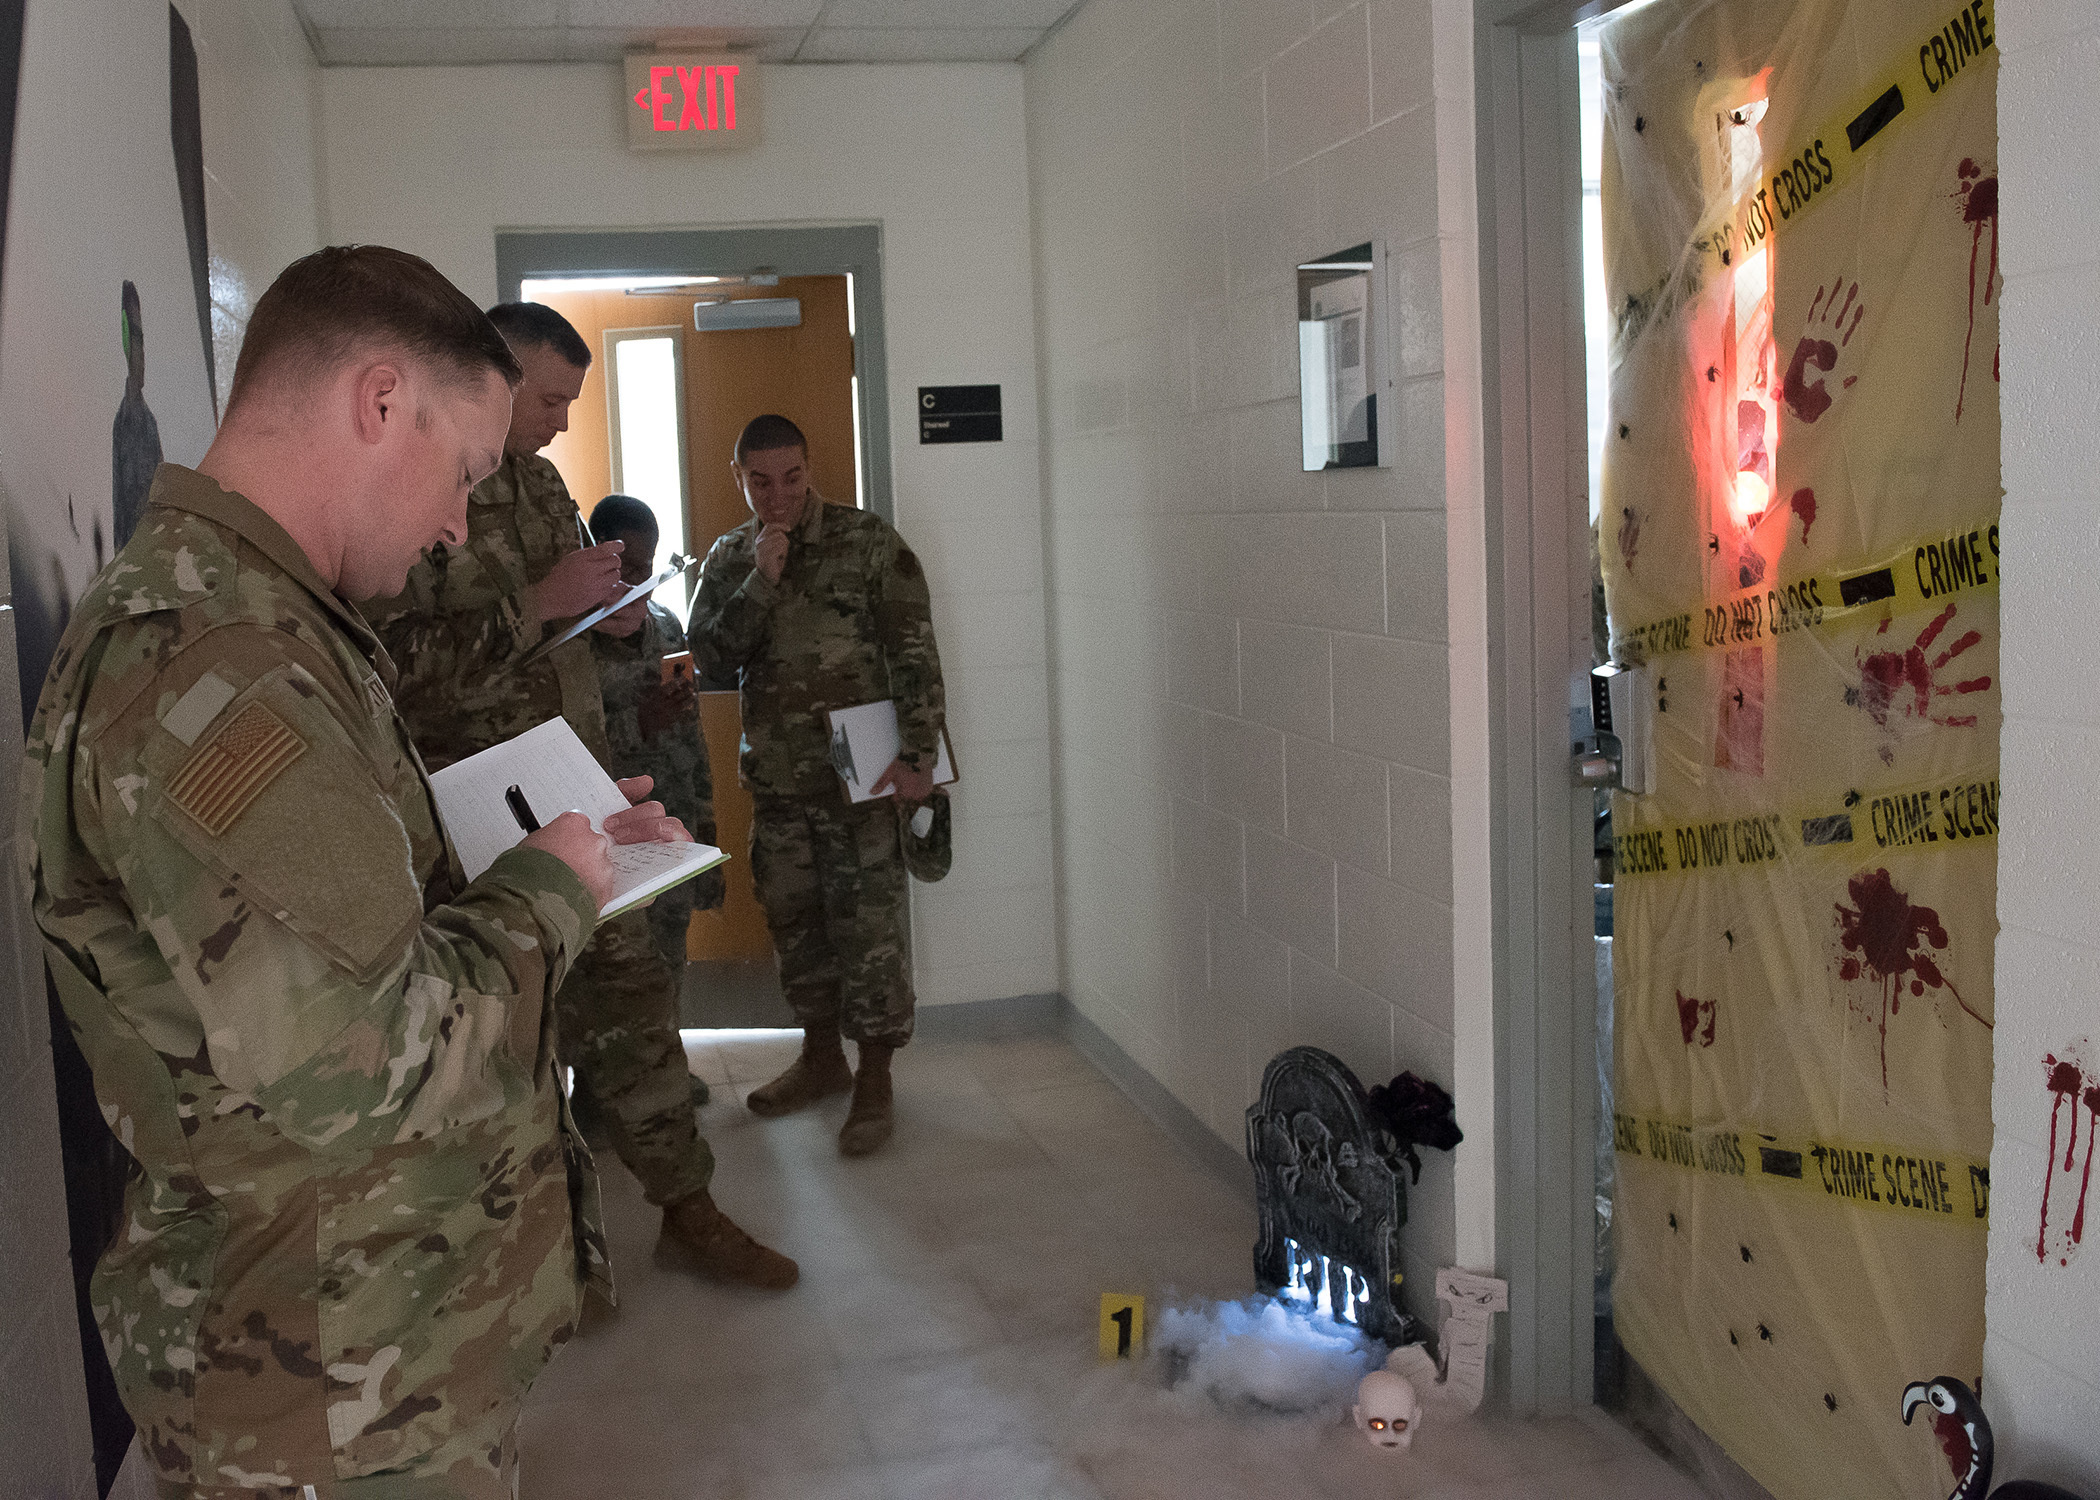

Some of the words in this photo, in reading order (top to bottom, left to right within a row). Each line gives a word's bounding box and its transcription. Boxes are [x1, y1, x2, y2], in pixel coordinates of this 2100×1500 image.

[650, 66, 739, 131] EXIT
[1743, 188, 1774, 252] NOT
[1772, 139, 1832, 220] CROSS
[1920, 0, 1993, 93] CRIME
[922, 394, 935, 409] C
[1704, 605, 1726, 647] DO
[1730, 595, 1762, 643] NOT
[1915, 530, 1988, 599] CRIME
[1627, 830, 1668, 874] SCENE
[1676, 827, 1698, 869] DO
[1699, 822, 1729, 867] NOT
[1872, 791, 1939, 848] CRIME
[1648, 1120, 1667, 1162] DO
[1669, 1124, 1695, 1167] NOT
[1700, 1132, 1745, 1176] CROSS
[1818, 1146, 1880, 1202] CRIME
[1882, 1153, 1953, 1213] SCENE
[1284, 1237, 1370, 1324] RIP
[1112, 1307, 1132, 1358] 1
